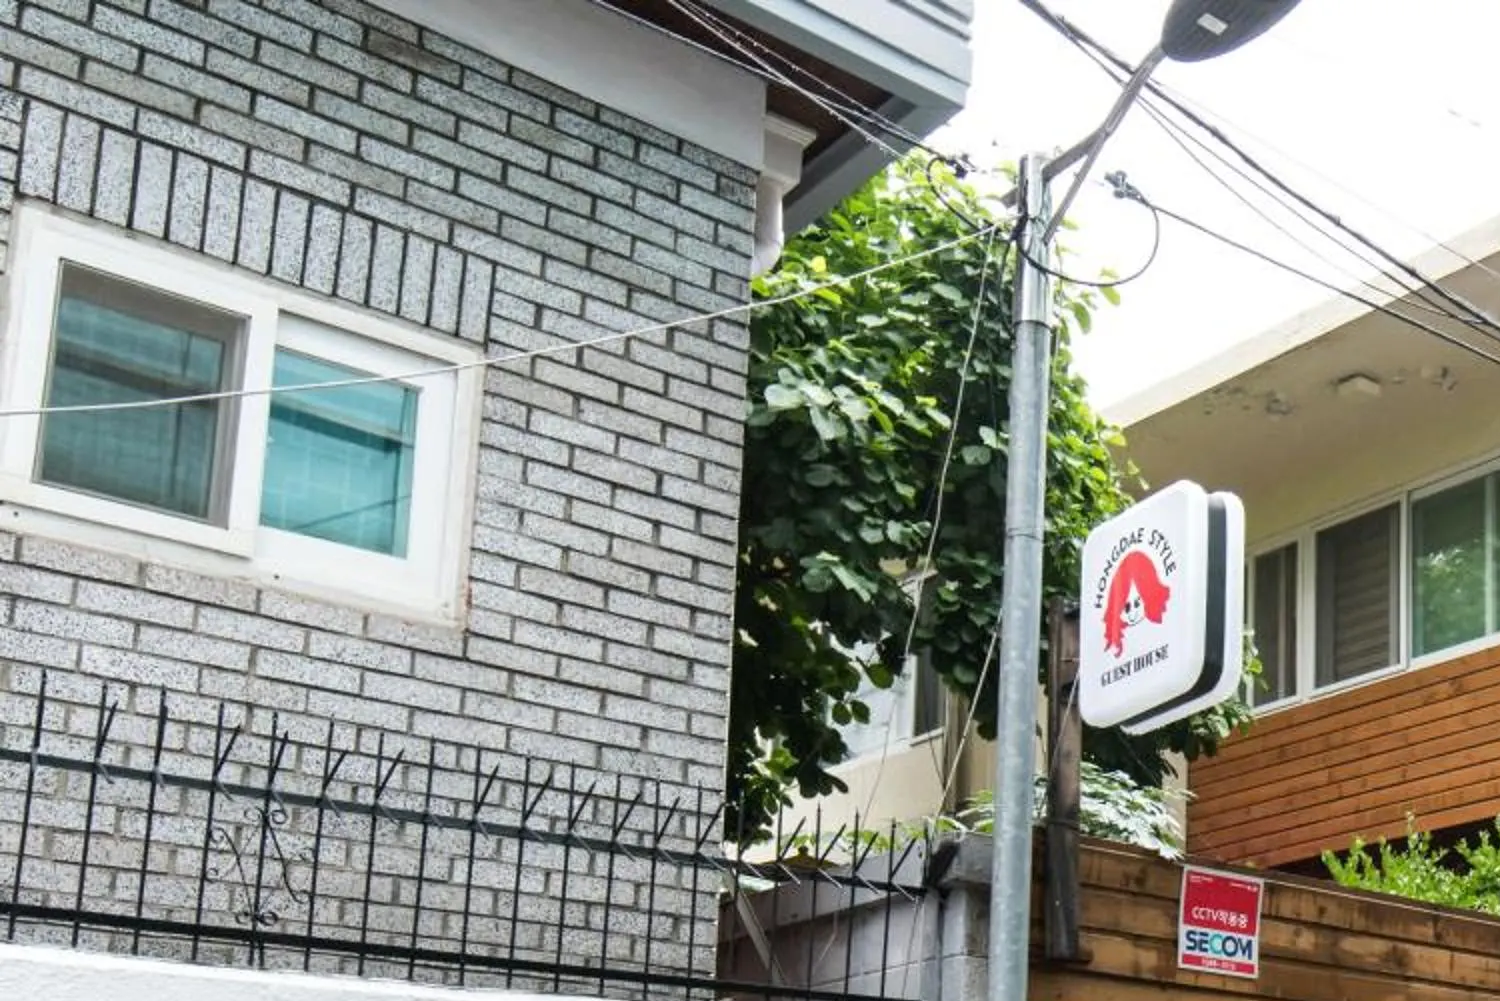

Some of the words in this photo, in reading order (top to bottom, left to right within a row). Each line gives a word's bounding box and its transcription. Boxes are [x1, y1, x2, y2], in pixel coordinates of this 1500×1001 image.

[1094, 527, 1146, 609] HONGDAE
[1148, 529, 1177, 577] STYLE
[1186, 930, 1253, 960] SECOM
